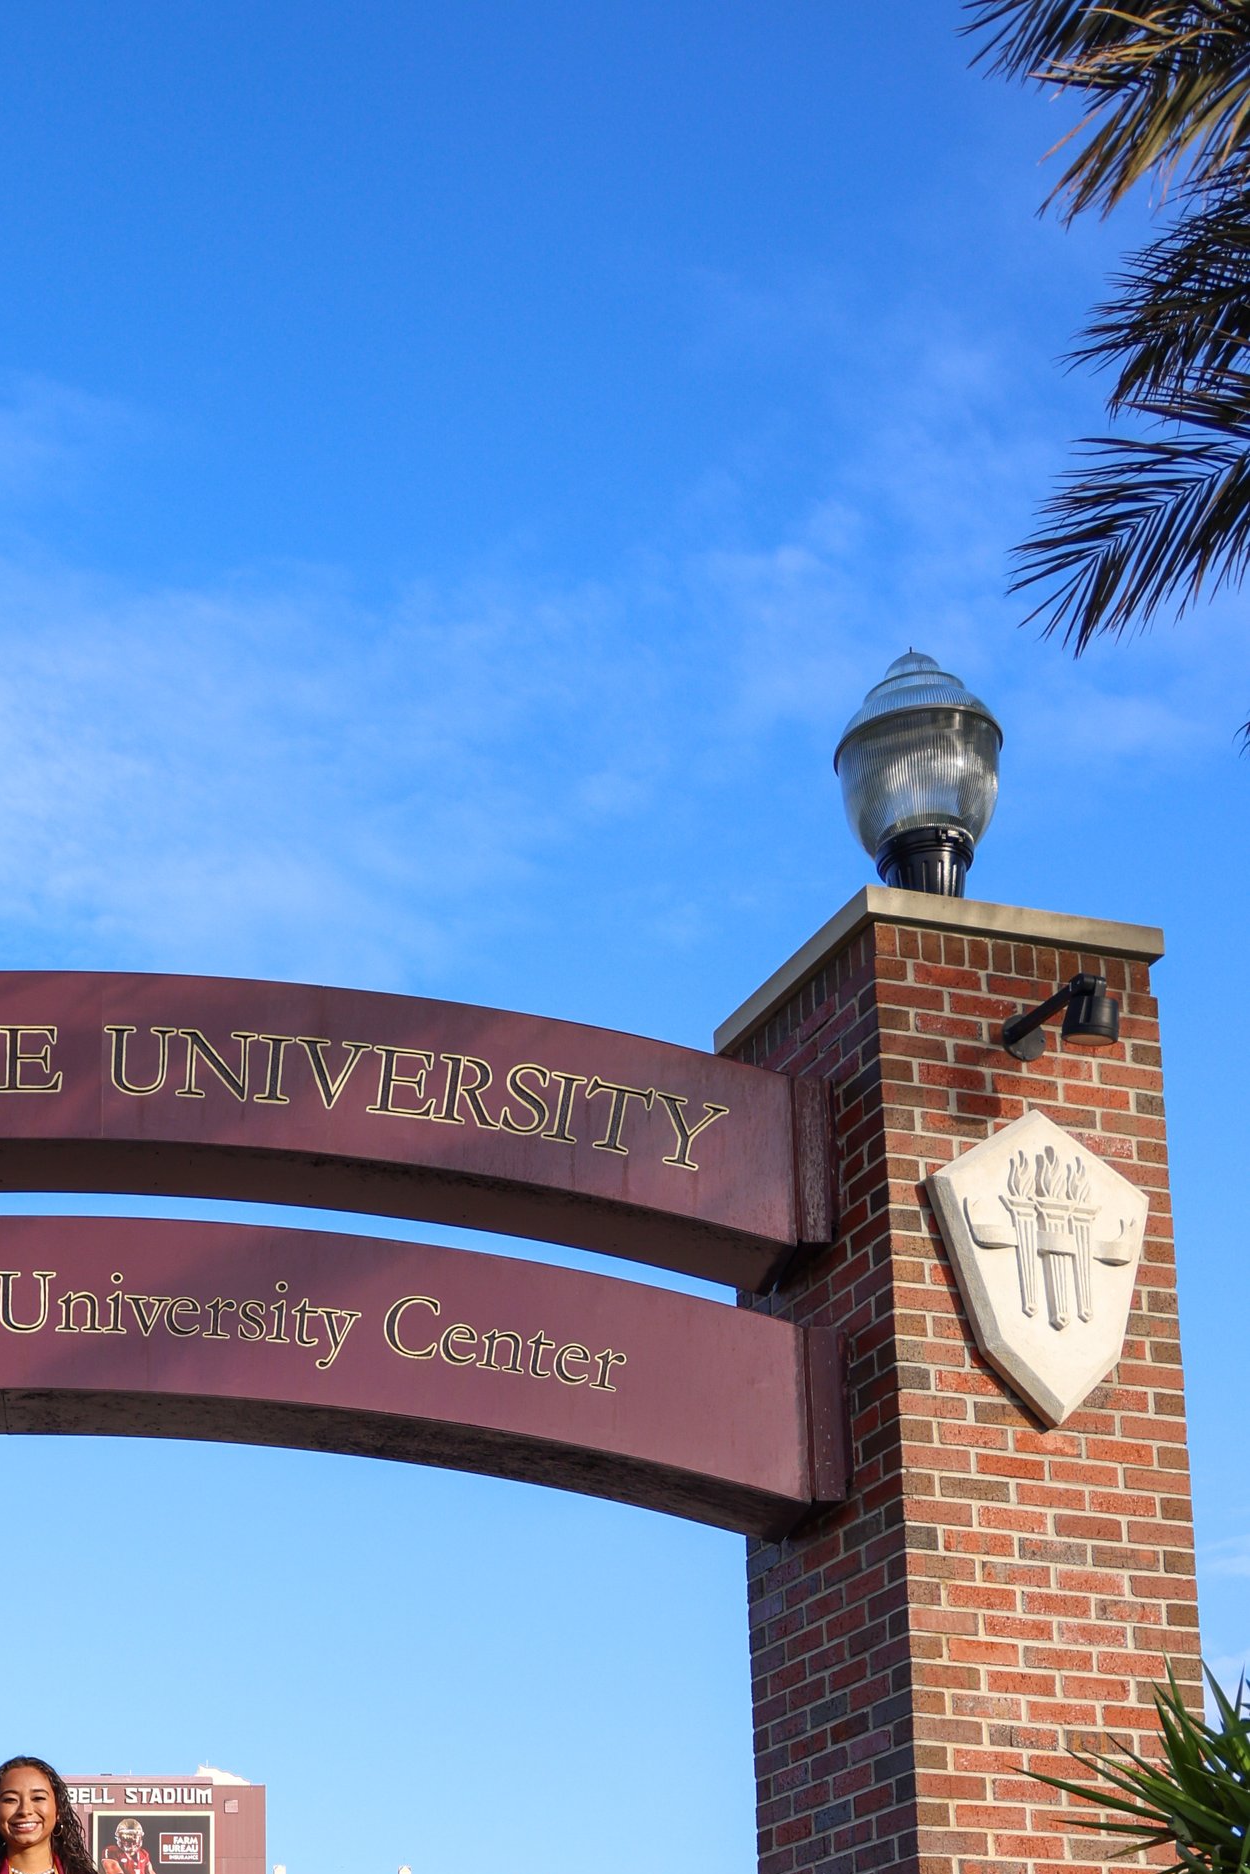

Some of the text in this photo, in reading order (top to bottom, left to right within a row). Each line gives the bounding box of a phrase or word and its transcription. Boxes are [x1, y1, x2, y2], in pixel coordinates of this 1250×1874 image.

[104, 1024, 730, 1172] UNIVERSITY
[383, 1295, 628, 1392] Center
[67, 1786, 115, 1804] BELL
[125, 1786, 213, 1805] STADIUM
[162, 1844, 199, 1853] BUREAU
[173, 1836, 199, 1845] FARM
